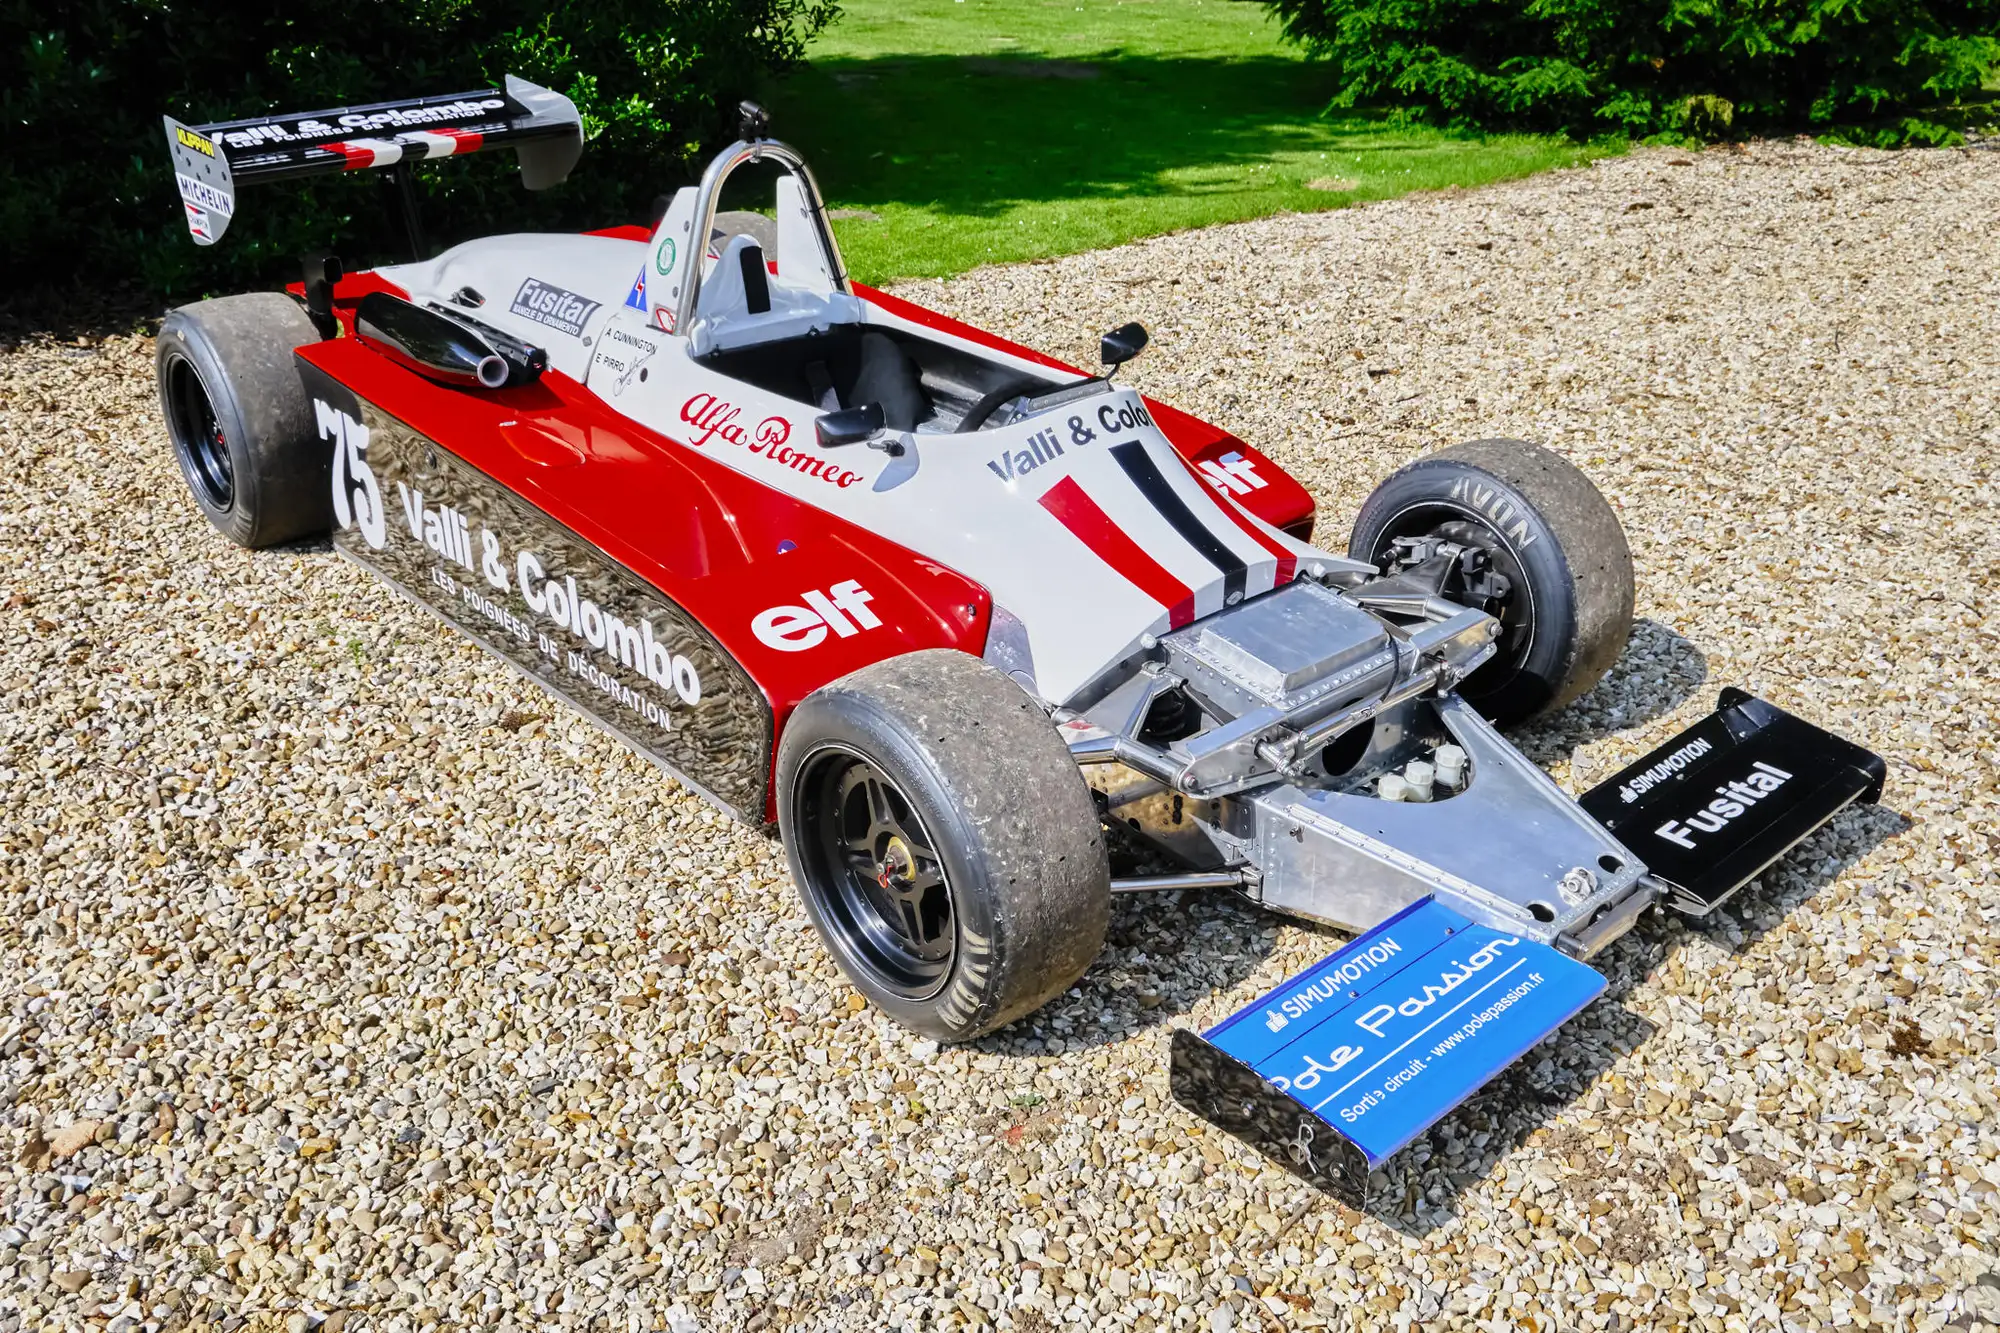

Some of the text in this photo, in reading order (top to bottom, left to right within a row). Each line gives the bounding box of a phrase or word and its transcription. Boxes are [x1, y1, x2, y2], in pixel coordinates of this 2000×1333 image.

[298, 120, 332, 133] &
[338, 99, 505, 127] Colombo
[180, 177, 232, 215] MICHELIN
[516, 278, 598, 326] Fusital
[536, 311, 545, 322] DI
[605, 327, 658, 354] A CUNNINGTON
[595, 353, 625, 373] E PIRRO
[313, 397, 386, 551] 75
[680, 393, 864, 488] Alfa Romeo
[987, 400, 1155, 486] Valli & Colo
[1451, 475, 1540, 551] AVON
[397, 480, 701, 706] Valli & Colombo
[750, 578, 883, 652] elf
[431, 566, 671, 732] LES POIGNÉES DE DÉCORATION
[1629, 736, 1713, 794] SIMUMOTION
[1654, 760, 1794, 850] Fusital
[936, 923, 991, 1031] AVON
[1281, 936, 1403, 1020] SIMUMOTION
[1355, 936, 1520, 1039] Passion
[1384, 1058, 1428, 1092] circuit
[1430, 970, 1546, 1058] www.polepassion.fr
